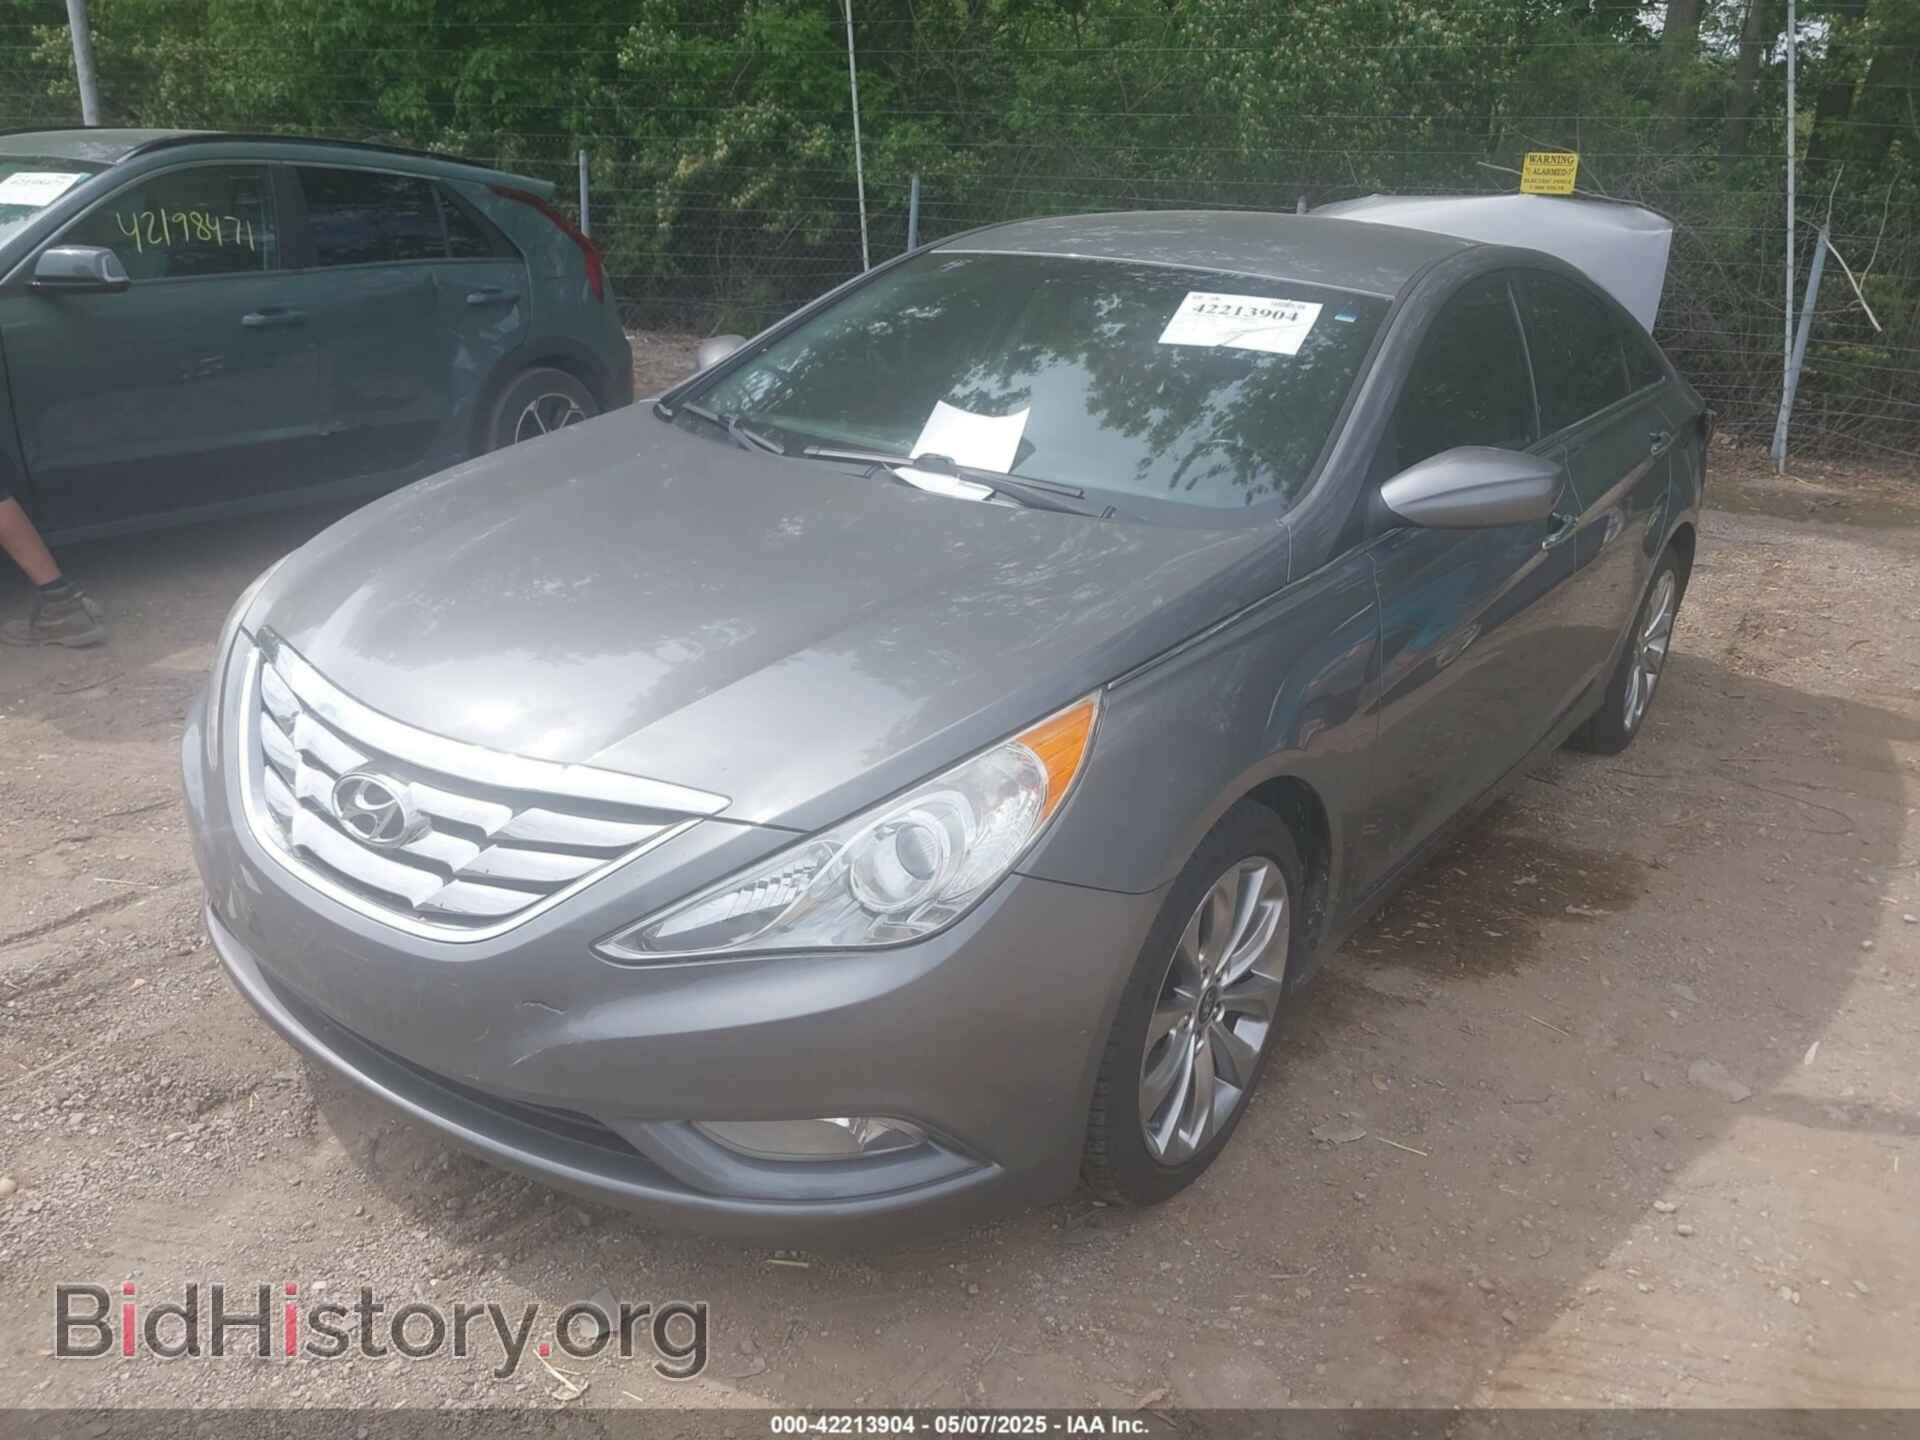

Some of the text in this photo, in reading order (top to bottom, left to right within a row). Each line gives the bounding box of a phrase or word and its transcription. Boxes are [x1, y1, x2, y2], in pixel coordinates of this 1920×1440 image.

[1529, 154, 1575, 165] WARNING
[115, 208, 255, 254] 42198471
[1193, 303, 1299, 322] 42213904
